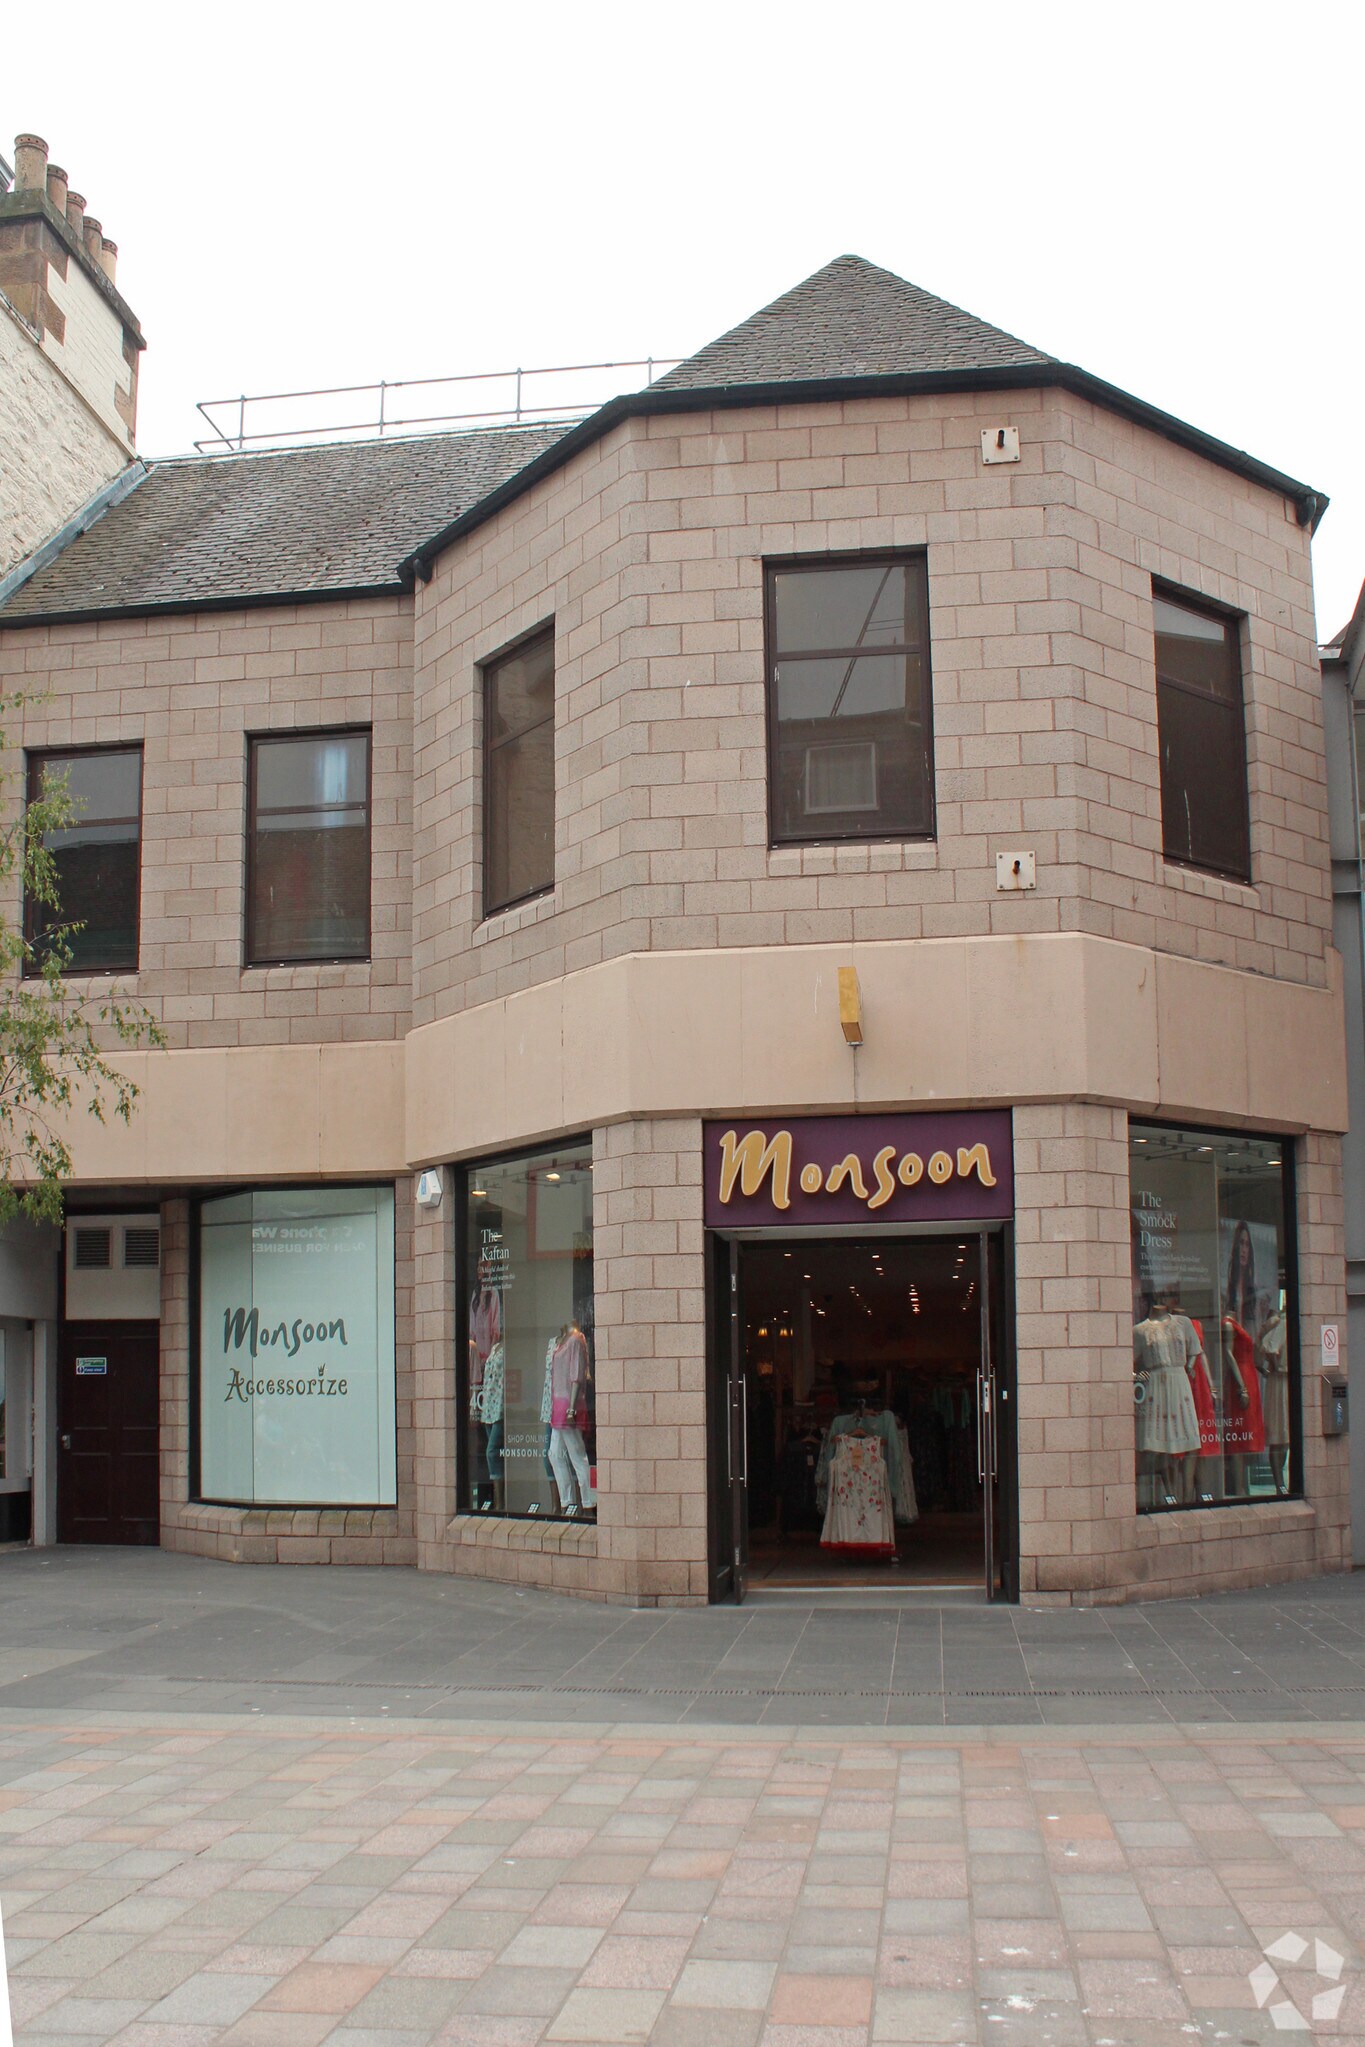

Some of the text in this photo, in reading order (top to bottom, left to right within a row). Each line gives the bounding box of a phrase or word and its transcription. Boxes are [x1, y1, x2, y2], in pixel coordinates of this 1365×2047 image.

[718, 1129, 997, 1210] Monsoon
[1138, 1190, 1162, 1208] The
[1139, 1210, 1176, 1229] Smock
[481, 1228, 499, 1244] The
[1140, 1230, 1173, 1248] Dress
[481, 1245, 510, 1262] Kaftan
[223, 1306, 348, 1358] Monsoon
[224, 1363, 348, 1402] Accessorize
[1205, 1418, 1233, 1428] ONLINE
[1234, 1418, 1244, 1427] AT
[507, 1434, 549, 1443] SHOP ONLINE
